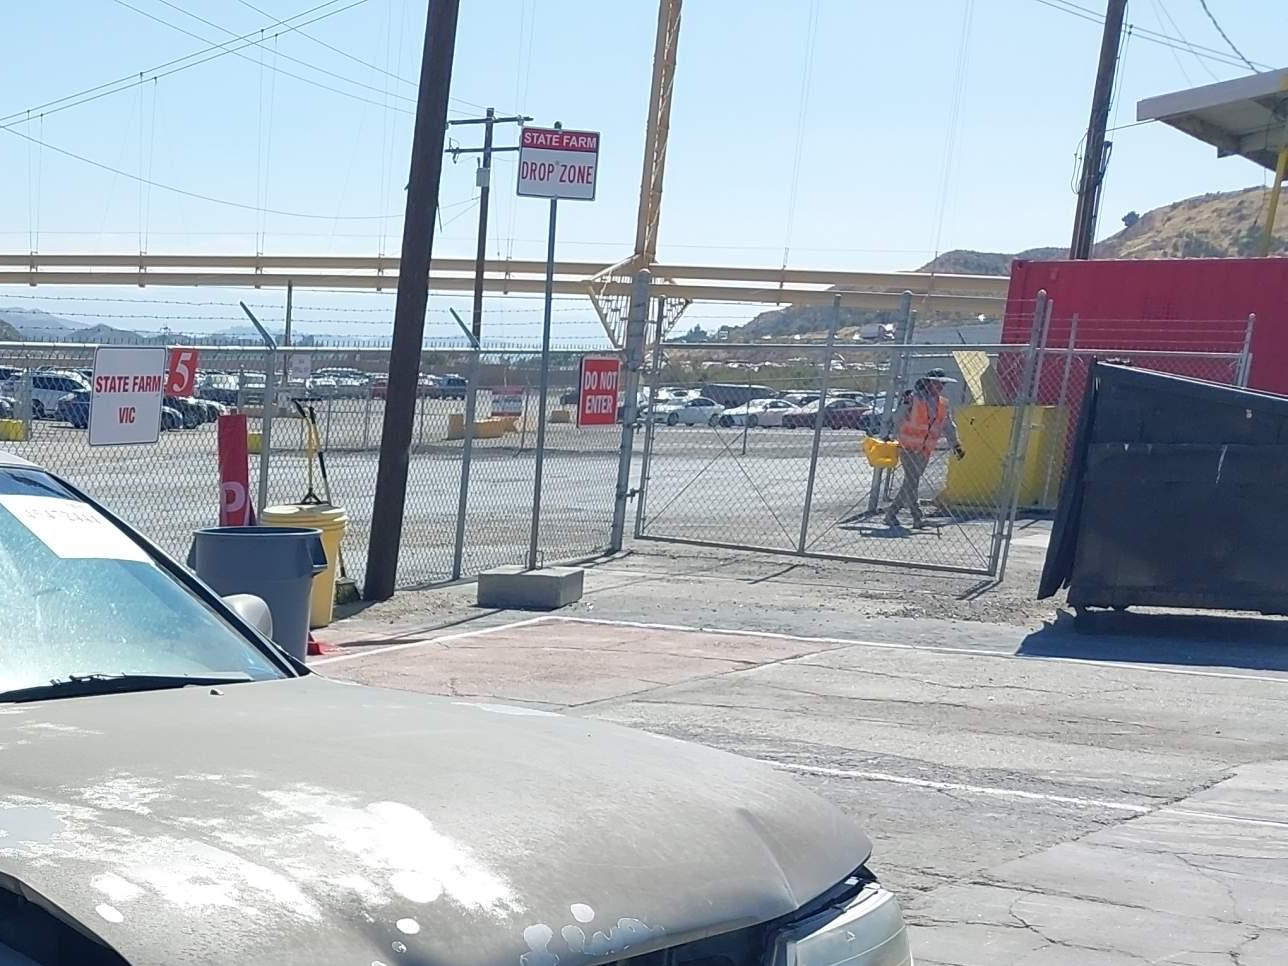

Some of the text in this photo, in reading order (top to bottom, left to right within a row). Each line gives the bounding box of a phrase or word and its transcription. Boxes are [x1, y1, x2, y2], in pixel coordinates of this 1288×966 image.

[524, 132, 597, 149] STATE FARM
[521, 161, 594, 185] DROP ZONE
[172, 352, 193, 392] 5
[584, 371, 618, 390] DO NOT
[95, 375, 162, 393] STATE FARM
[585, 395, 614, 414] ENTER
[118, 406, 136, 424] VIC
